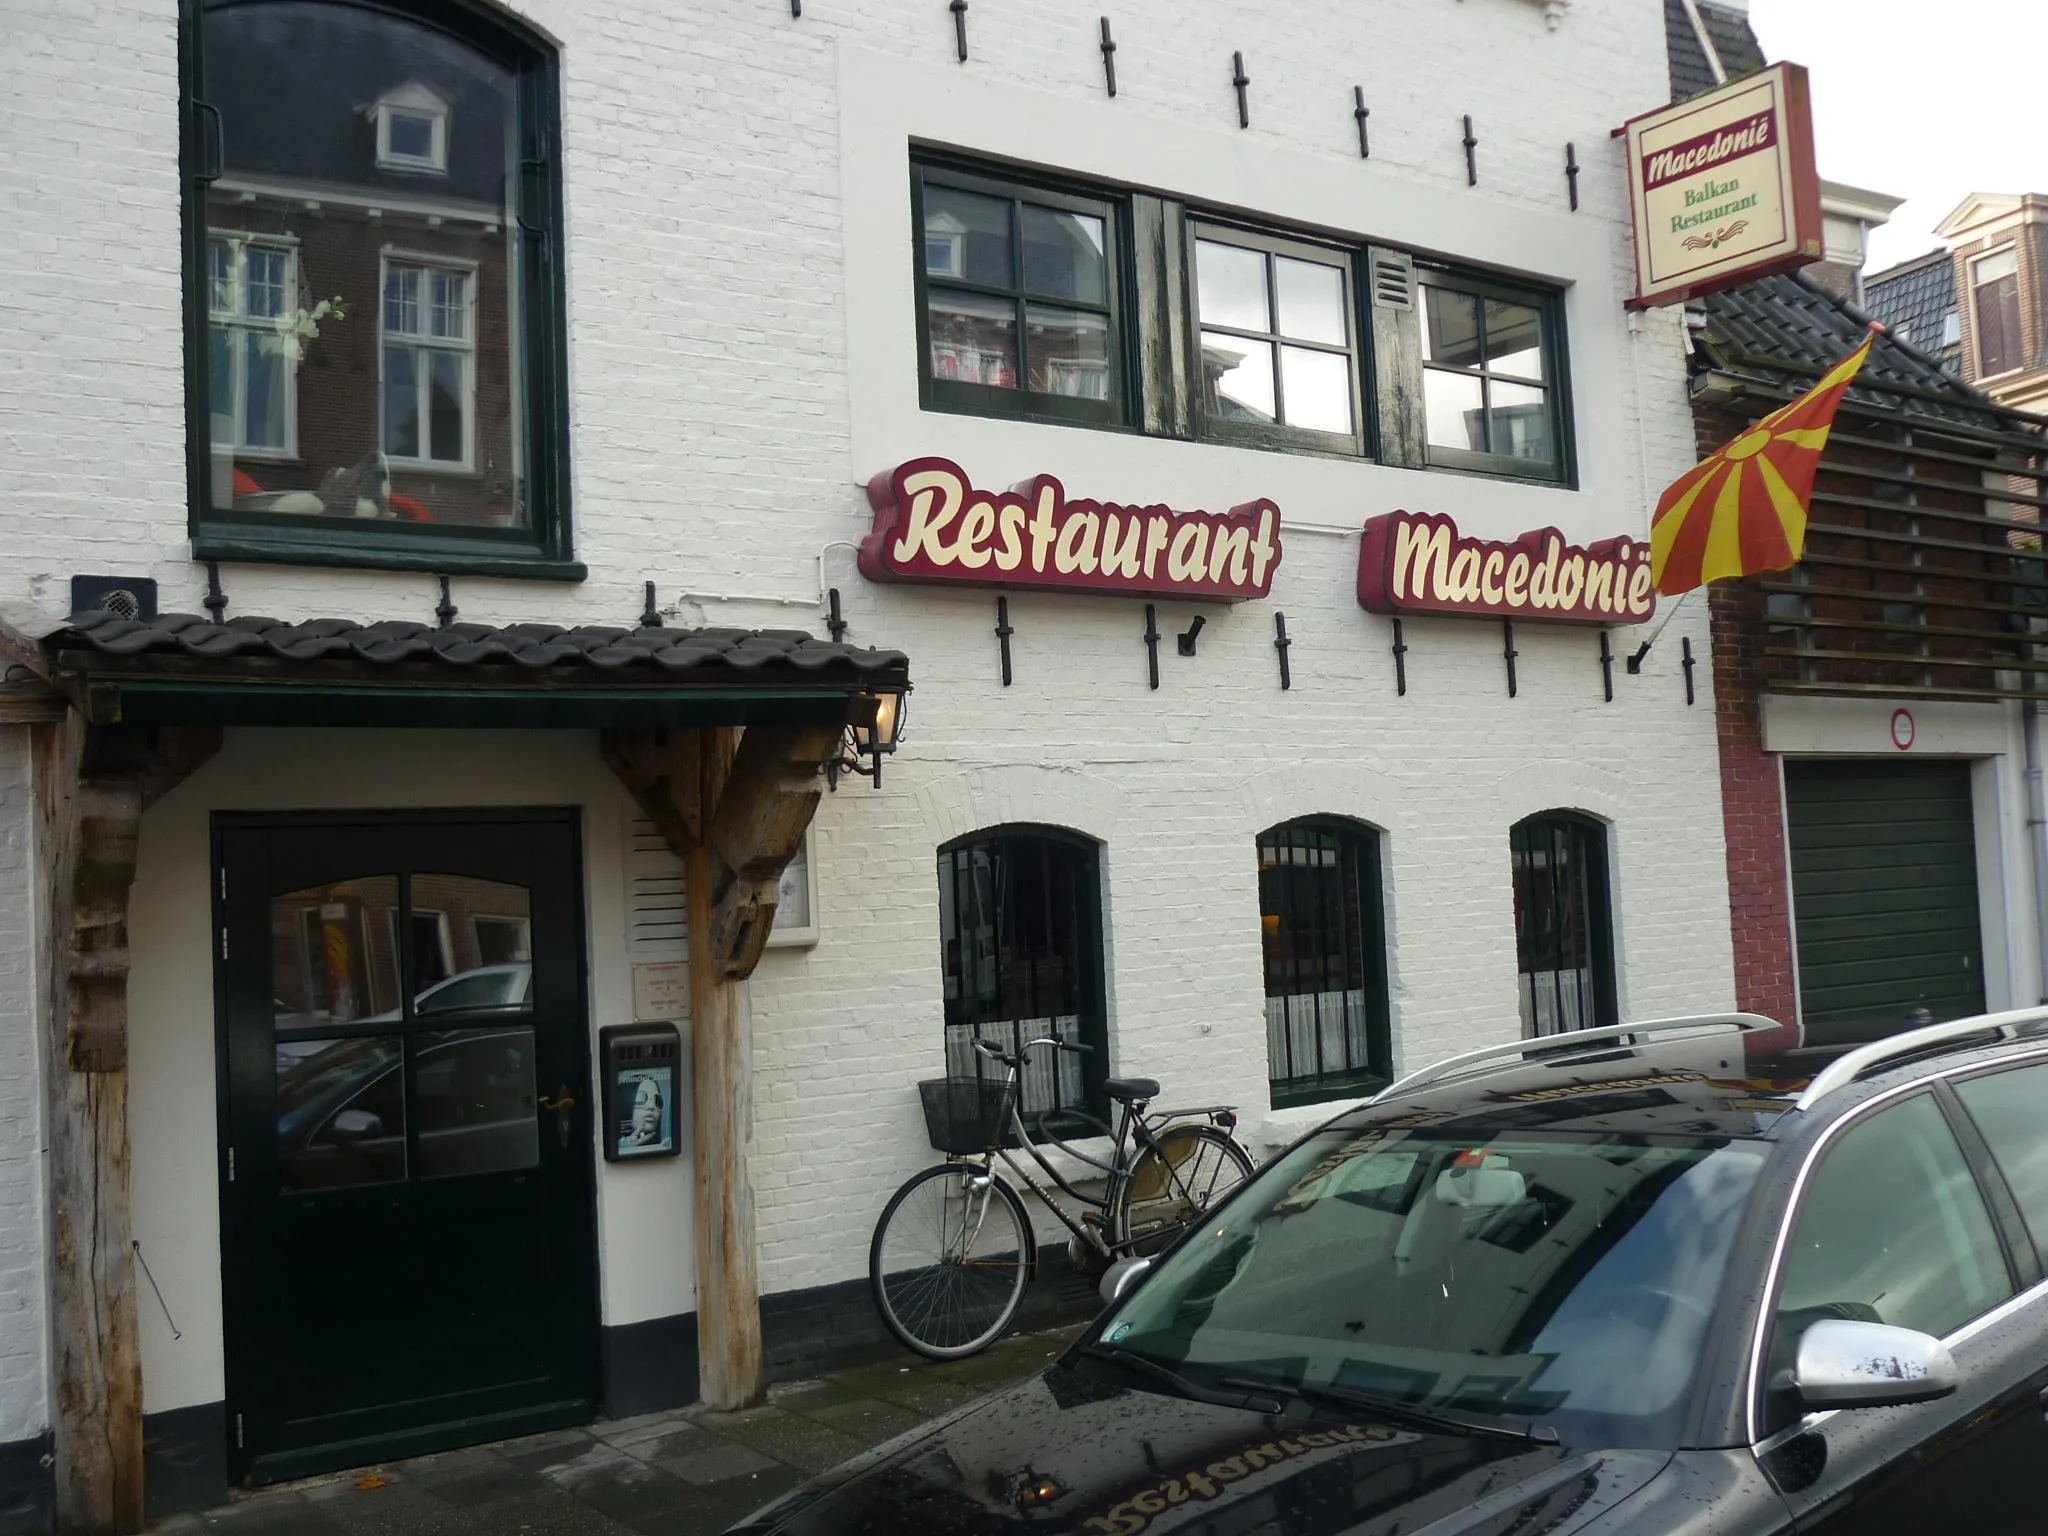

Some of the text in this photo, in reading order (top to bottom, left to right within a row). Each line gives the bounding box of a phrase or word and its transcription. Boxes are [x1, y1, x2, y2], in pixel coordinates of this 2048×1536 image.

[1648, 116, 1768, 183] Macedonië
[1670, 193, 1758, 233] Restaurant
[1684, 178, 1740, 207] Balkan
[894, 470, 1652, 615] Restaurant Macedonië
